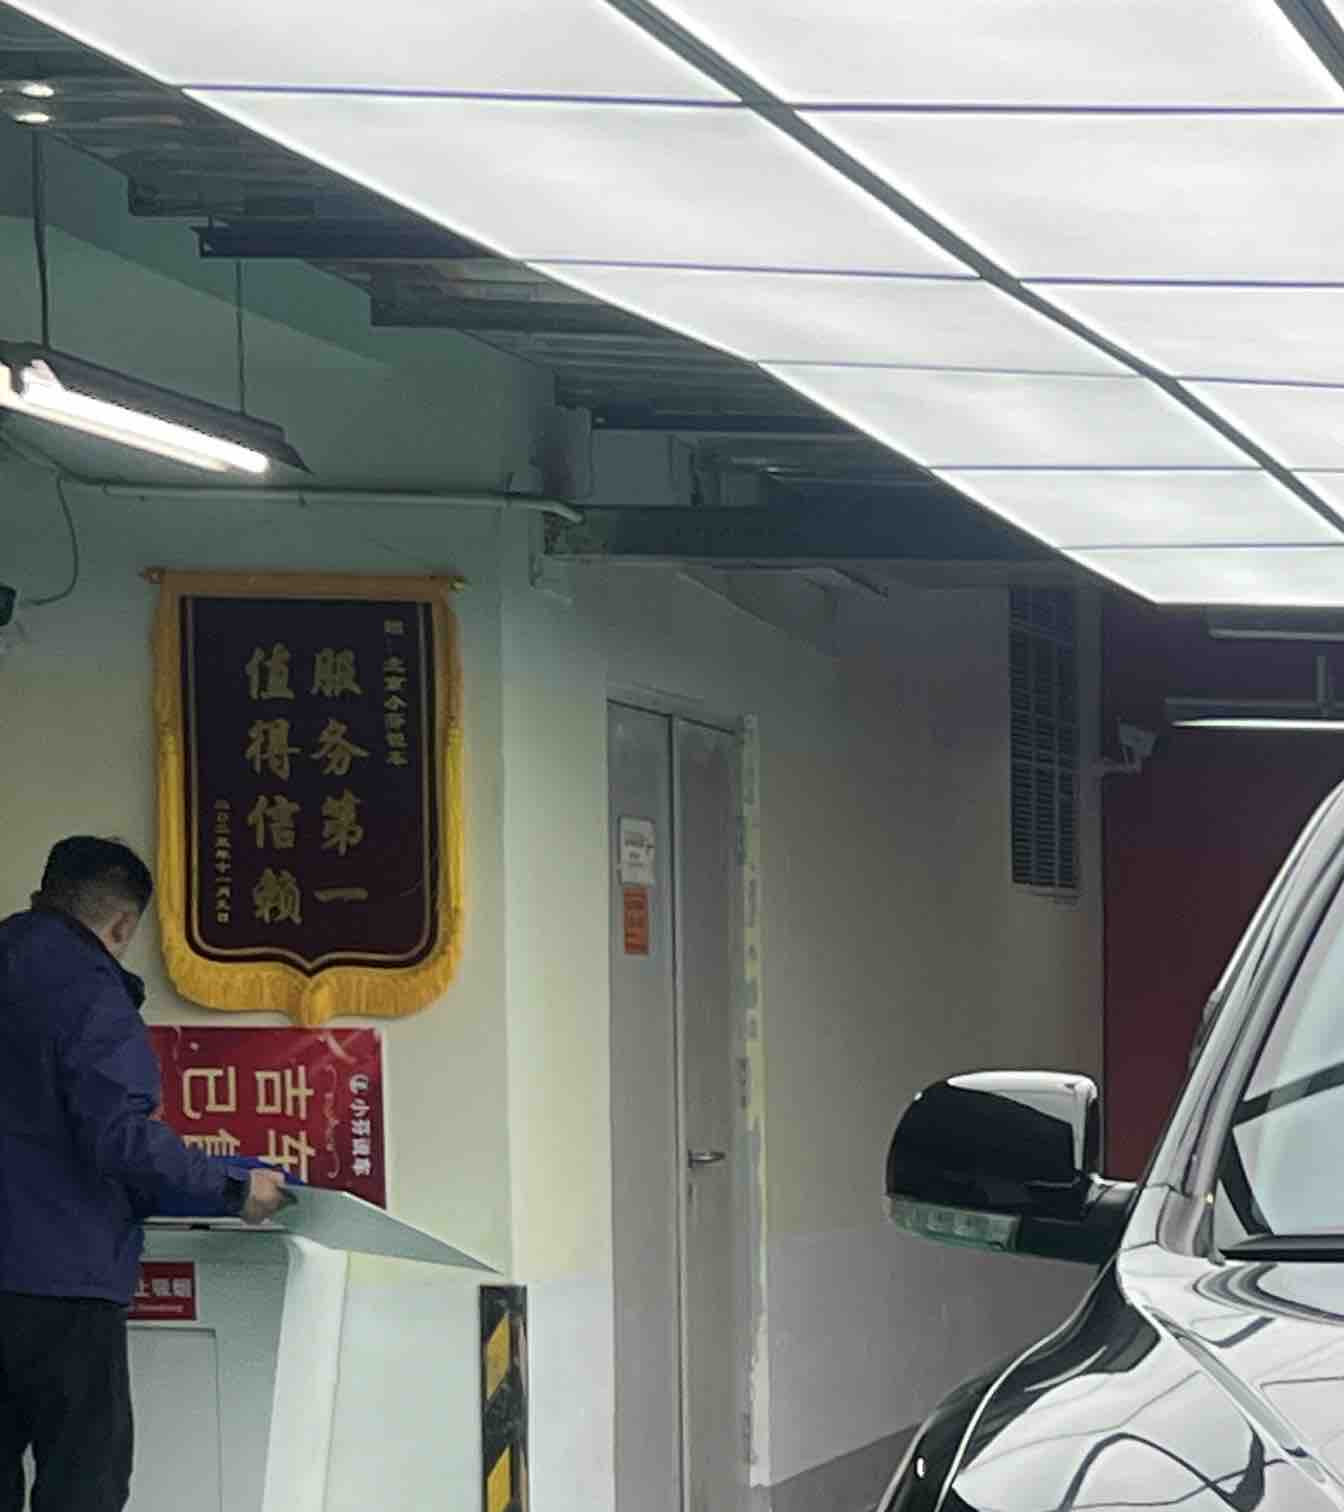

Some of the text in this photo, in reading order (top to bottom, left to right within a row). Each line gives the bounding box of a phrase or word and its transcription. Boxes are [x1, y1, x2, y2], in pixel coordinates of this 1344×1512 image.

[245, 643, 302, 925] 值得信赖
[310, 648, 369, 901] 服务第一
